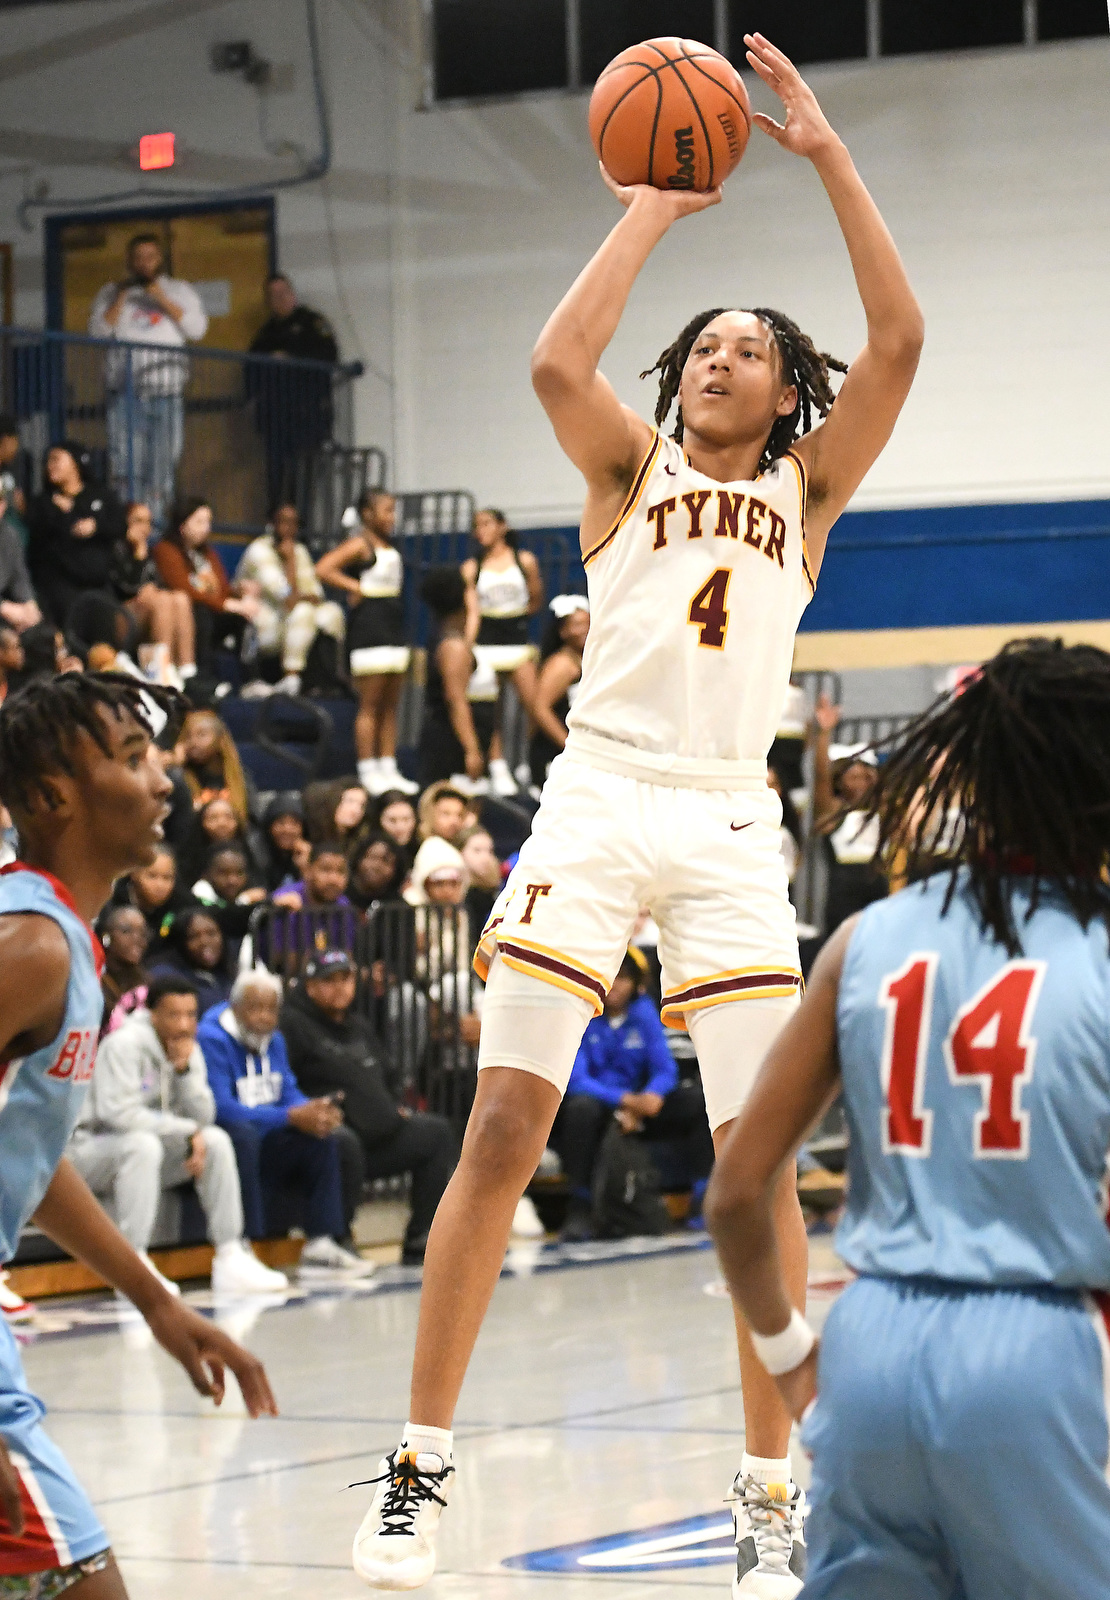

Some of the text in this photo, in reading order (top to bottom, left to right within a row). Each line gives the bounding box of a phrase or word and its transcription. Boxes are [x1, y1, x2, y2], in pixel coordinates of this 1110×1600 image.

[646, 490, 787, 570] TYNER
[687, 566, 733, 651] 4
[517, 883, 553, 926] T
[877, 951, 1048, 1161] 14
